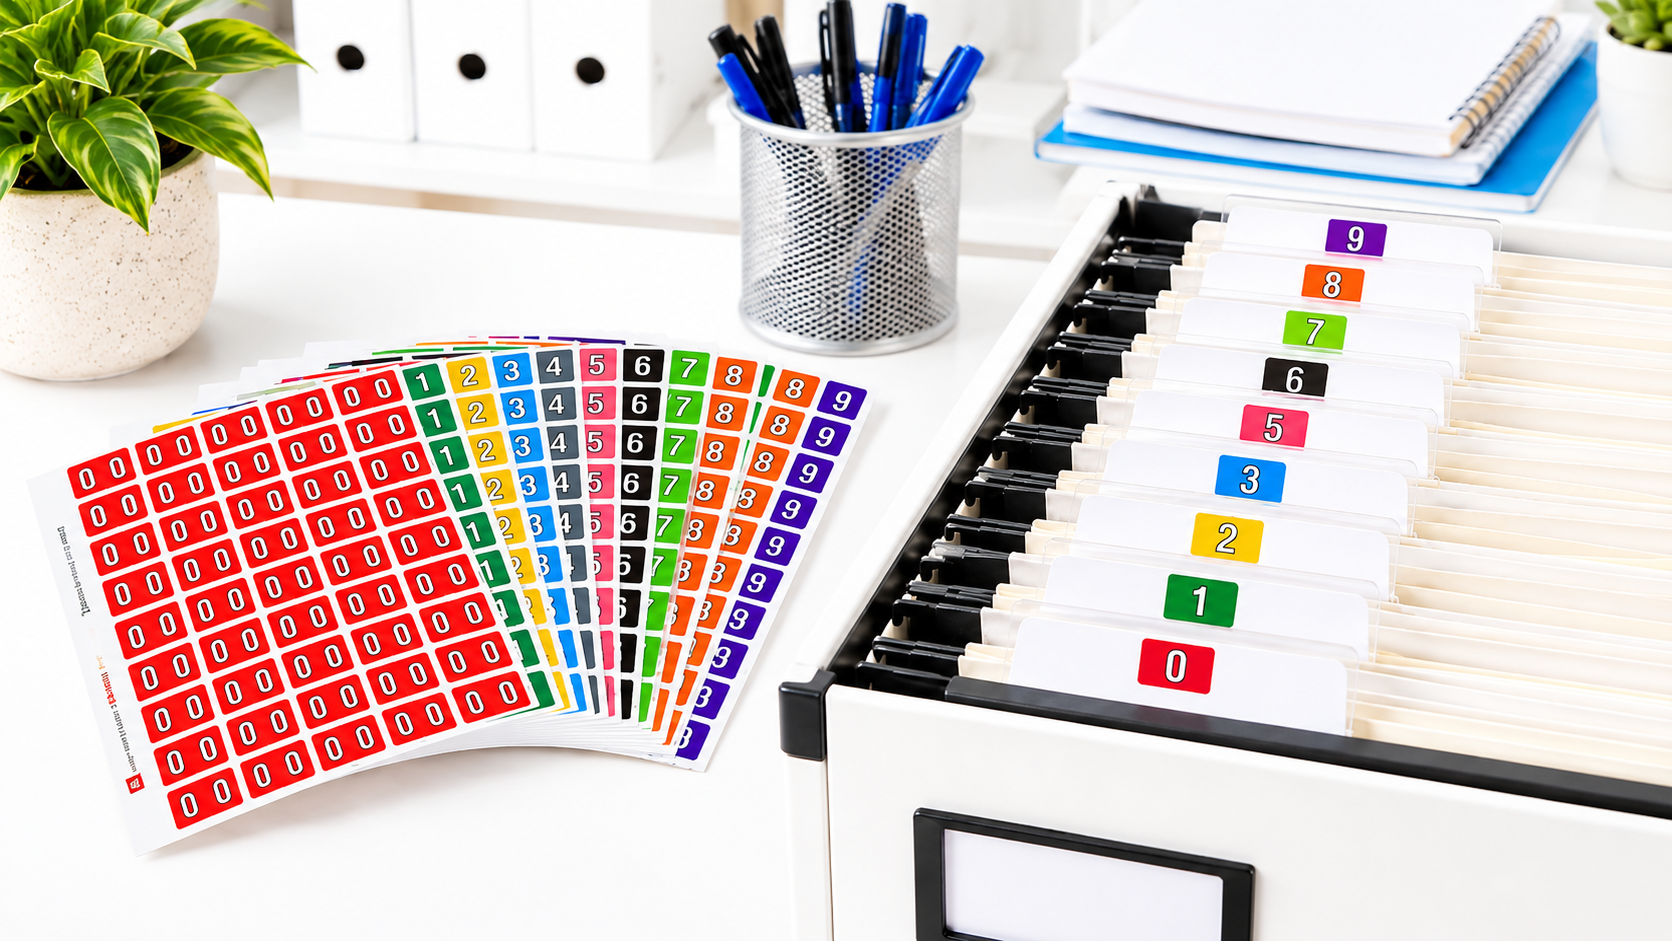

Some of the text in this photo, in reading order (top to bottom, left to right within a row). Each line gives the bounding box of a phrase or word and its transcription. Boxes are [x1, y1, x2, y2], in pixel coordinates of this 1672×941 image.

[1346, 226, 1364, 252] 9
[1323, 271, 1342, 298] 8
[1307, 318, 1325, 345] 7
[460, 365, 478, 387] 2
[503, 360, 520, 381] 3
[545, 356, 562, 376] 4
[589, 354, 605, 375] 5
[634, 355, 651, 376] 6
[681, 358, 698, 378] 7
[724, 365, 743, 386] 8
[343, 378, 392, 407] 0 0
[415, 372, 430, 392] 1
[785, 378, 805, 399] 8
[1285, 366, 1304, 393] 6
[276, 396, 323, 426] 0 0
[468, 402, 486, 424] 2
[508, 397, 526, 419] 3
[548, 394, 565, 414] 4
[587, 393, 604, 414] 5
[631, 393, 648, 414] 6
[676, 396, 692, 417] 7
[714, 402, 734, 424] 8
[832, 390, 852, 412] 9
[211, 415, 258, 446] 0 0
[356, 414, 406, 444] 0 0
[427, 408, 442, 429] 1
[770, 414, 790, 436] 8
[1264, 413, 1284, 442] 5
[146, 434, 193, 466] 0 0
[289, 432, 337, 463] 0 0
[478, 439, 495, 462] 2
[514, 435, 531, 457] 3
[550, 432, 567, 453] 4
[587, 431, 603, 452] 5
[626, 432, 644, 454] 6
[669, 434, 686, 456] 7
[815, 426, 836, 448] 9
[439, 445, 454, 466] 1
[705, 440, 724, 462] 8
[754, 451, 774, 472] 8
[78, 456, 126, 490] 0 0
[224, 451, 271, 483] 0 0
[370, 450, 420, 481] 0 0
[798, 463, 819, 484] 9
[158, 472, 205, 504] 0 0
[303, 469, 352, 501] 0 0
[486, 478, 504, 501] 2
[520, 474, 537, 496] 3
[554, 471, 570, 493] 4
[588, 471, 602, 493] 5
[623, 472, 640, 494] 6
[663, 474, 679, 496] 7
[695, 480, 715, 501] 8
[1240, 465, 1260, 494] 3
[237, 489, 284, 520] 0 0
[385, 488, 435, 519] 0 0
[450, 483, 467, 504] 1
[737, 488, 757, 509] 8
[90, 494, 138, 528] 0 0
[317, 507, 366, 538] 0 0
[620, 512, 636, 534] 6
[781, 499, 802, 520] 9
[170, 510, 218, 542] 0 0
[466, 521, 481, 542] 1
[497, 516, 514, 539] 2
[529, 513, 544, 536] 3
[656, 514, 673, 537] 7
[686, 519, 704, 541] 8
[724, 524, 742, 546] 8
[102, 532, 150, 566] 0 0
[250, 527, 298, 560] 0 0
[400, 525, 450, 556] 0 0
[765, 536, 786, 556] 9
[1216, 523, 1238, 554] 2
[183, 548, 232, 582] 0 0
[332, 544, 381, 577] 0 0
[480, 559, 494, 580] 1
[114, 571, 164, 606] 0 0
[264, 565, 313, 599] 0 0
[415, 563, 467, 595] 0 0
[746, 572, 767, 593] 9
[196, 588, 245, 622] 0 0
[347, 584, 396, 616] 0 0
[1193, 586, 1207, 616] 1
[127, 612, 177, 649] 0 0
[279, 605, 328, 639] 0 0
[431, 601, 484, 634] 0 0
[728, 608, 749, 630] 9
[210, 628, 260, 663] 0 0
[362, 623, 412, 656] 0 0
[293, 644, 343, 679] 0 0
[447, 650, 467, 674] 0
[480, 640, 500, 664] 0
[1165, 650, 1187, 683] 0
[140, 653, 191, 690] 0 0
[378, 662, 428, 696] 0 0
[224, 668, 274, 705] 0 0
[465, 680, 518, 714] 0 0
[154, 694, 204, 732] 0 0
[308, 684, 359, 720] 0 0
[238, 709, 289, 746] 0 0
[394, 702, 444, 736] 0 0
[166, 736, 218, 775] 0 0
[324, 725, 375, 761] 0 0
[253, 750, 304, 788] 0 0
[180, 778, 232, 818] 0 0
